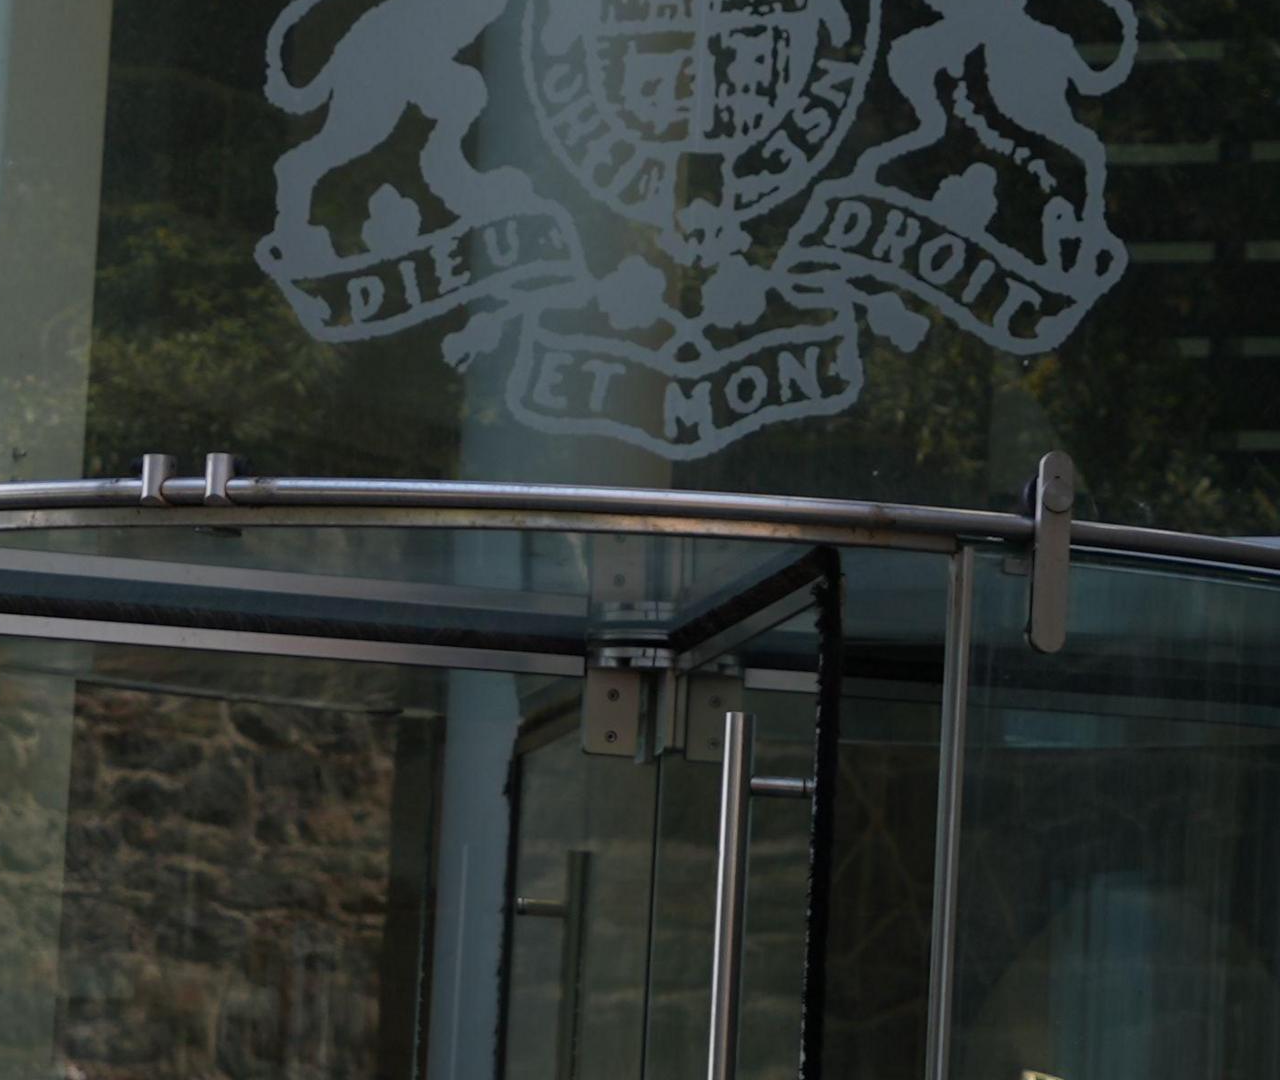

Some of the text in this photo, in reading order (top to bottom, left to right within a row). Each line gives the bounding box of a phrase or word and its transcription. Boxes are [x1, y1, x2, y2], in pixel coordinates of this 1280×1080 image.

[346, 219, 518, 324] DIEU
[822, 199, 1043, 333] DROIT
[532, 345, 823, 442] ET MON
